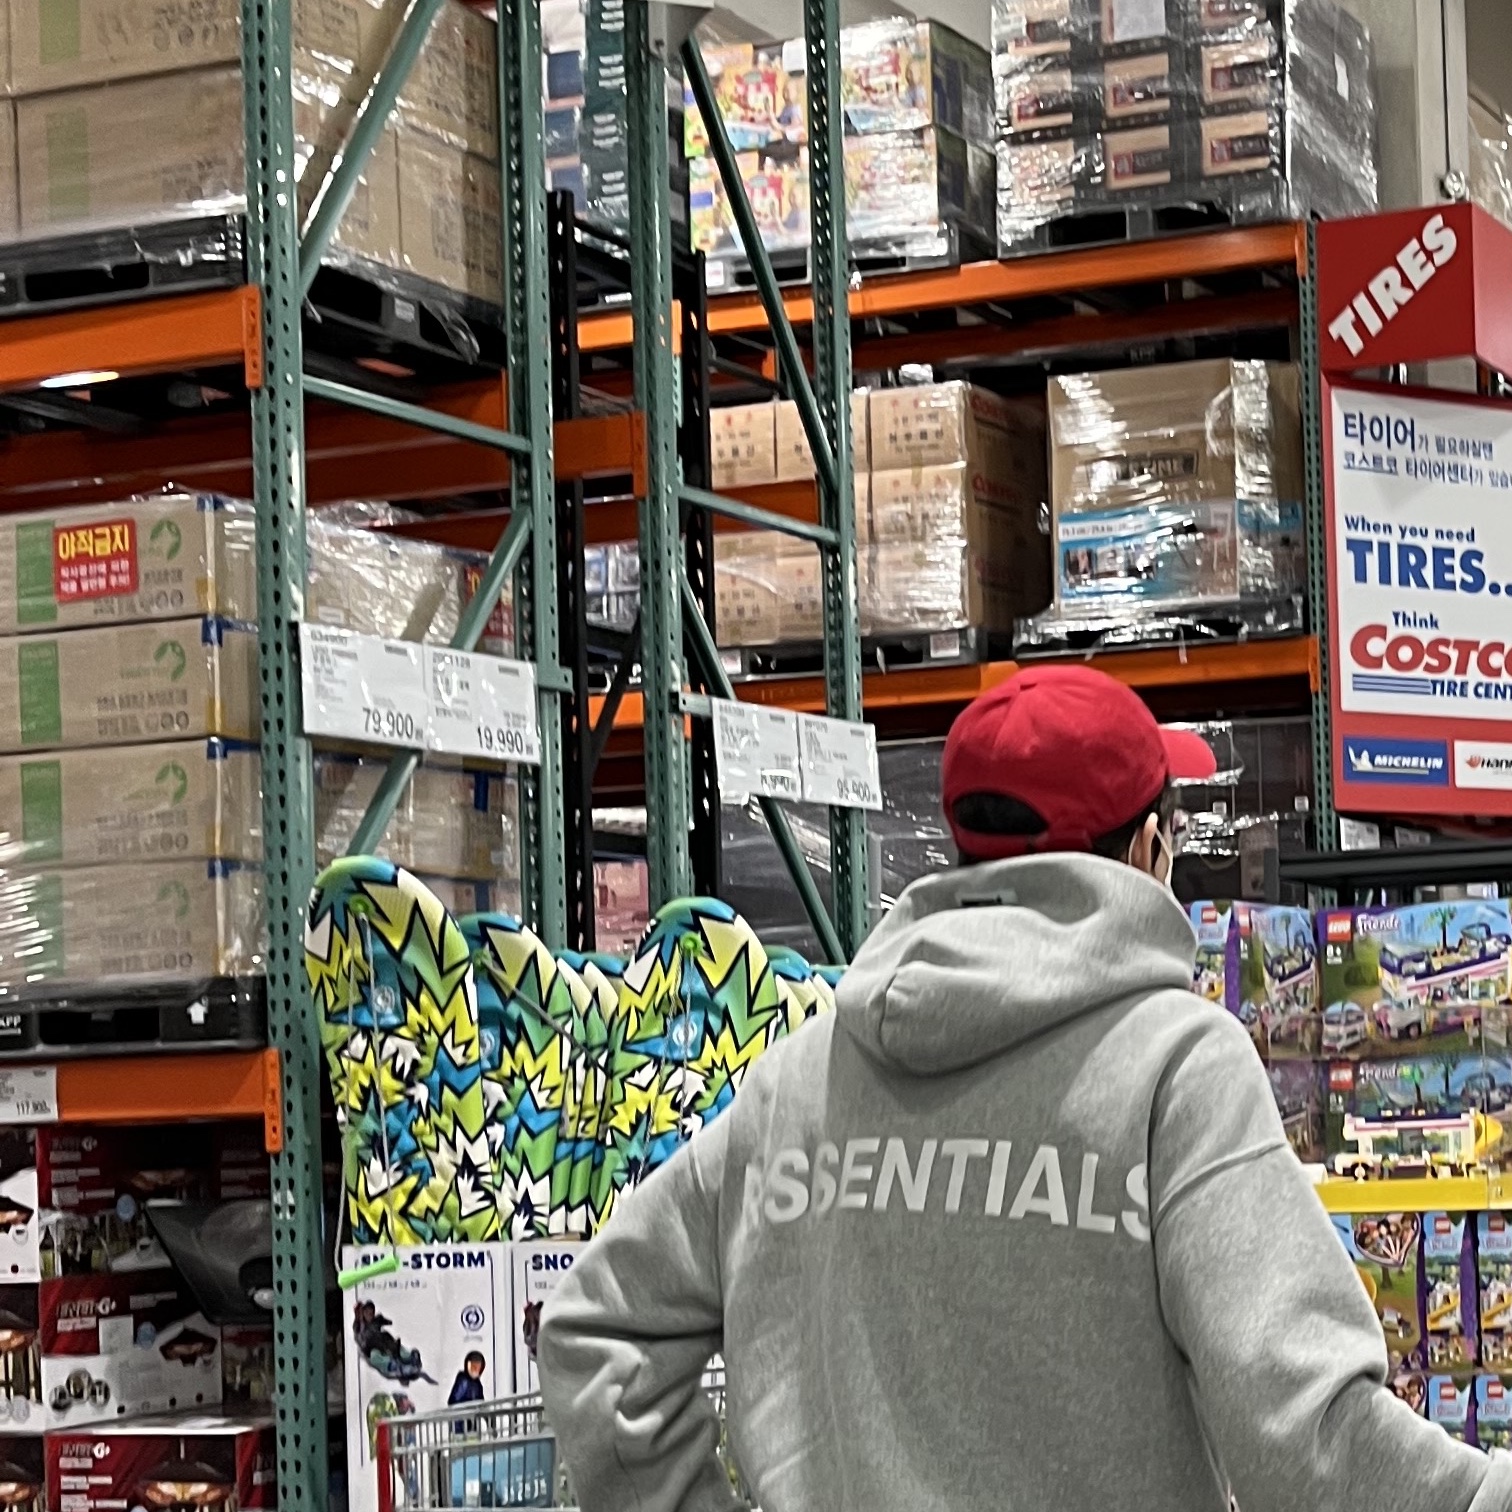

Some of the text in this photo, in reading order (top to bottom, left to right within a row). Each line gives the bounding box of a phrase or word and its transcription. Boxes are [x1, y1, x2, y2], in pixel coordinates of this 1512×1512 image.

[1328, 214, 1457, 357] TIRES
[1344, 514, 1475, 543] When you need
[1392, 610, 1440, 630] Think
[1430, 678, 1469, 697] TIRE
[1374, 754, 1443, 769] MICHELIN
[361, 1250, 486, 1271] SN-STORM
